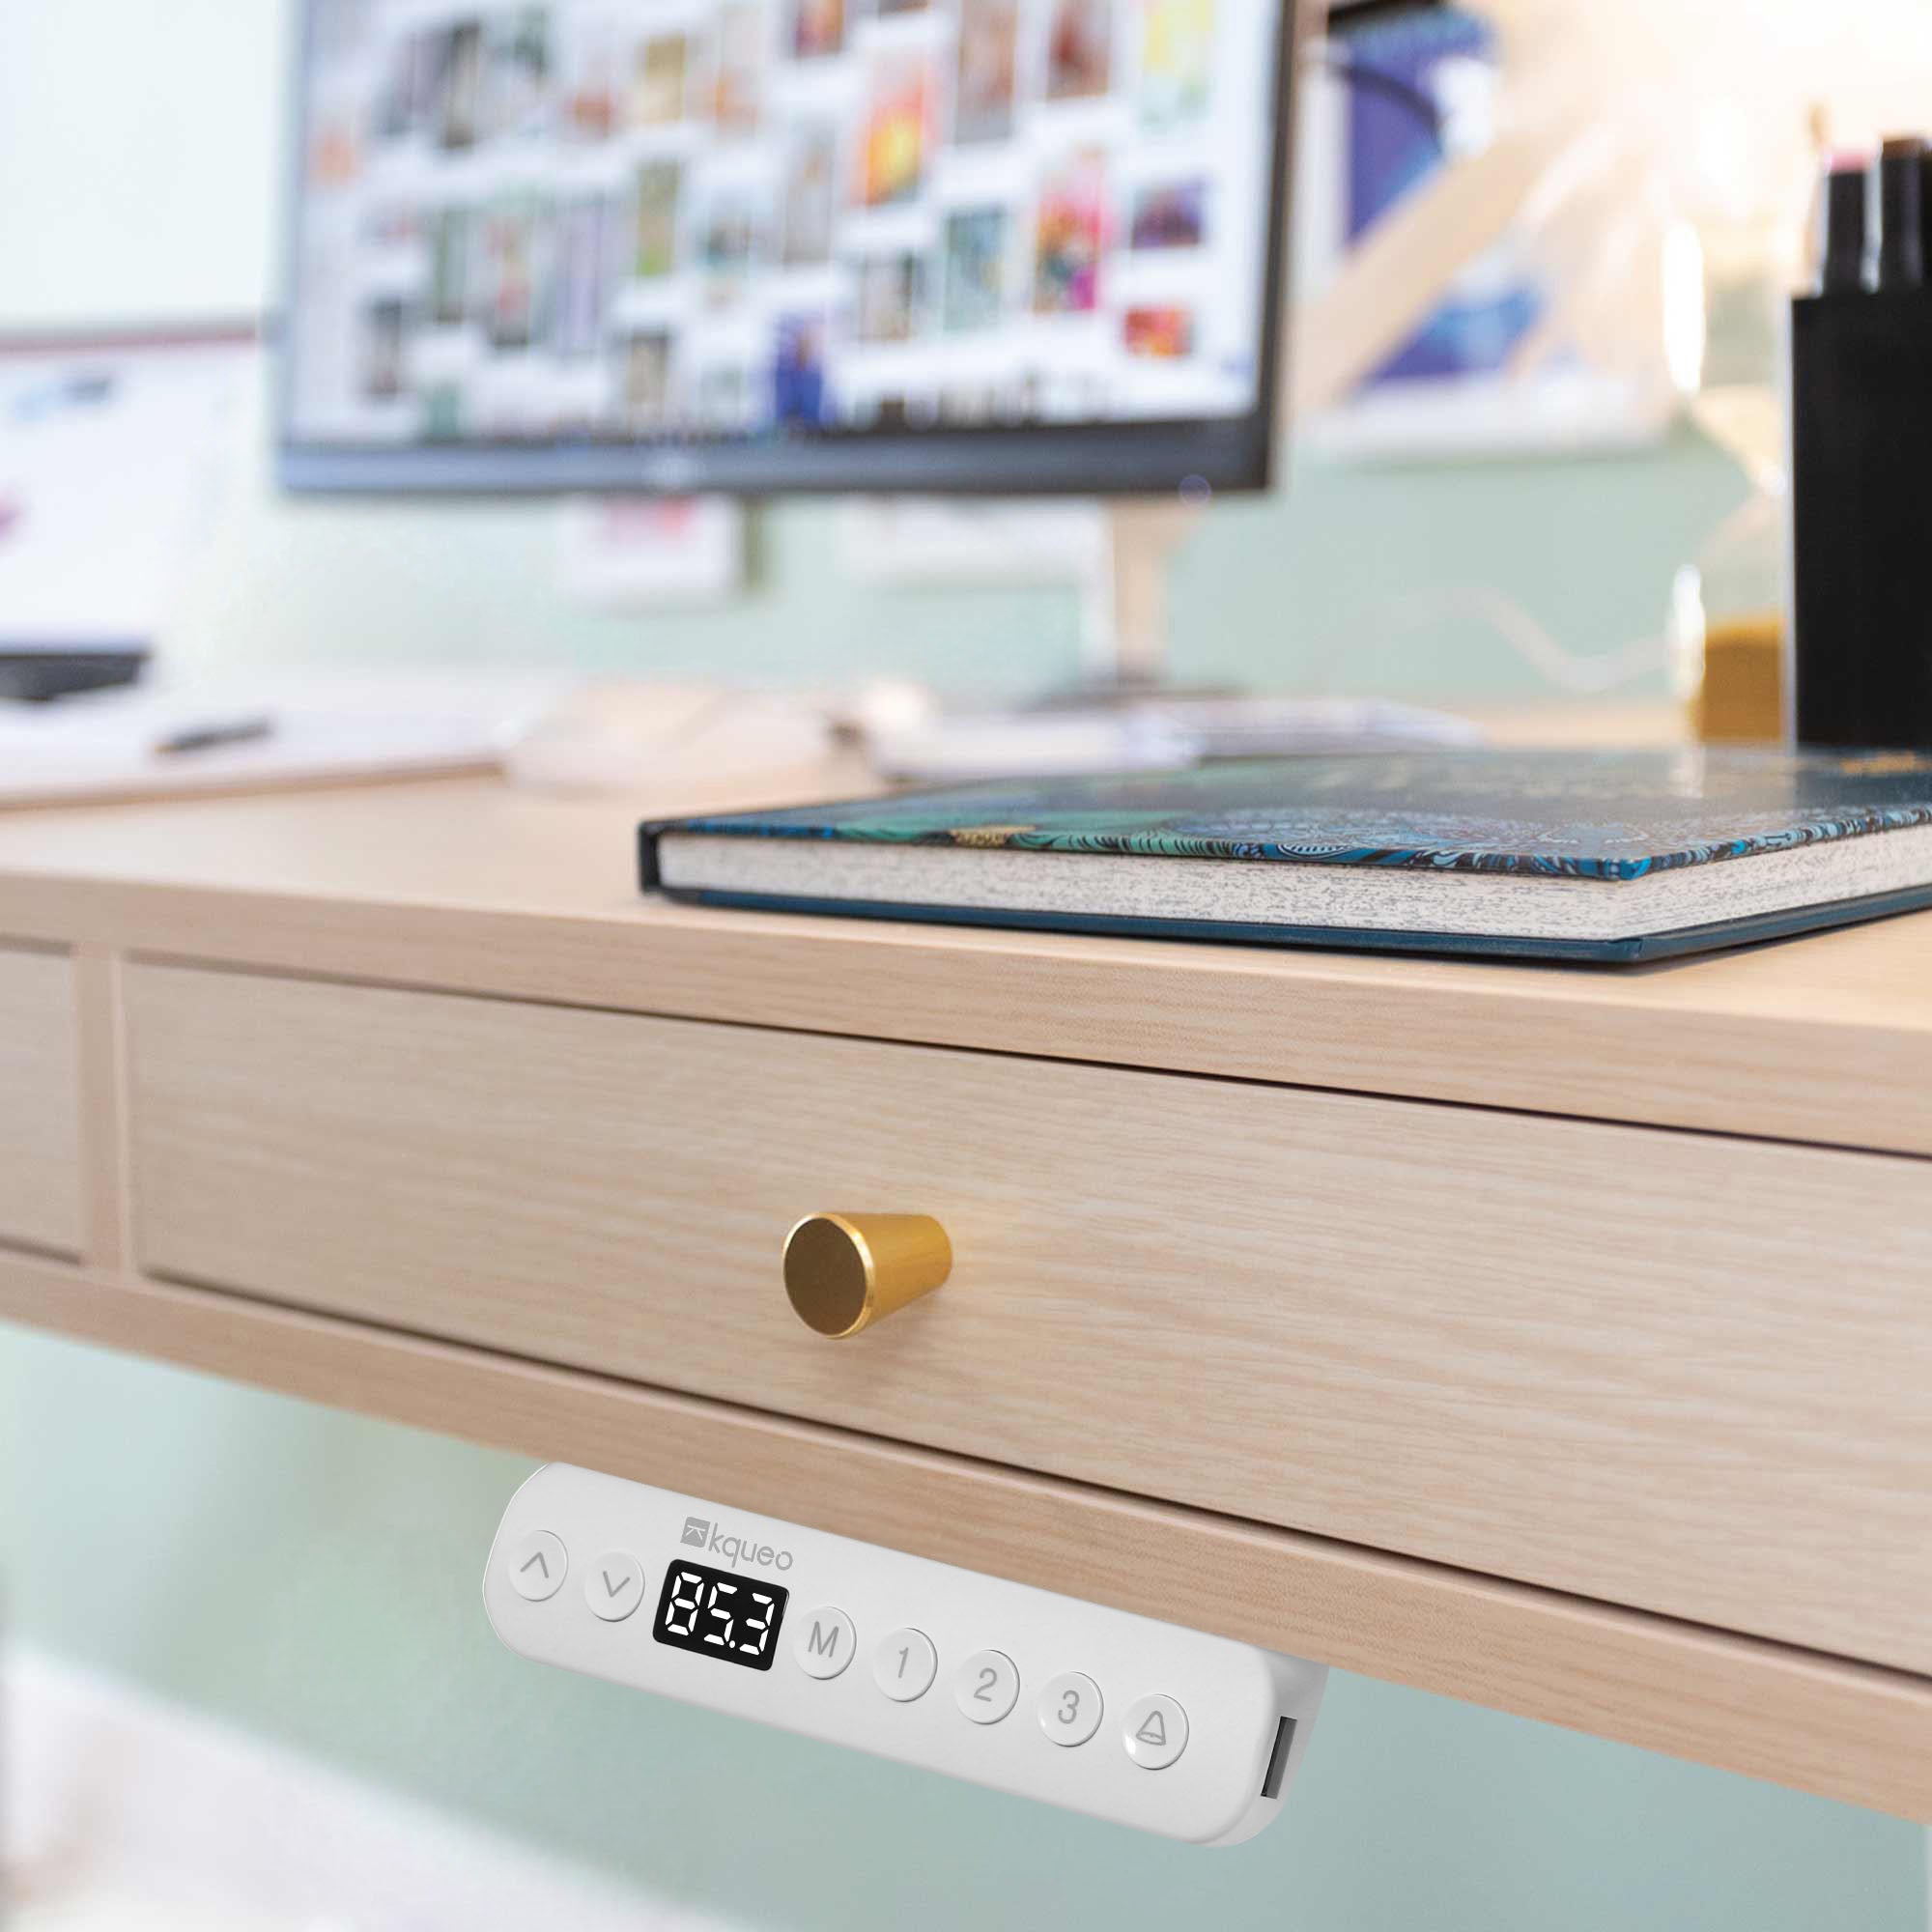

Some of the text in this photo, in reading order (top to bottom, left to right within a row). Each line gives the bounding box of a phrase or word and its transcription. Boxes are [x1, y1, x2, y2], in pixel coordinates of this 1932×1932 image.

[708, 1522, 793, 1571] kqueo
[665, 1572, 775, 1656] 85.3
[808, 1620, 1080, 1724] M 1 2 3
